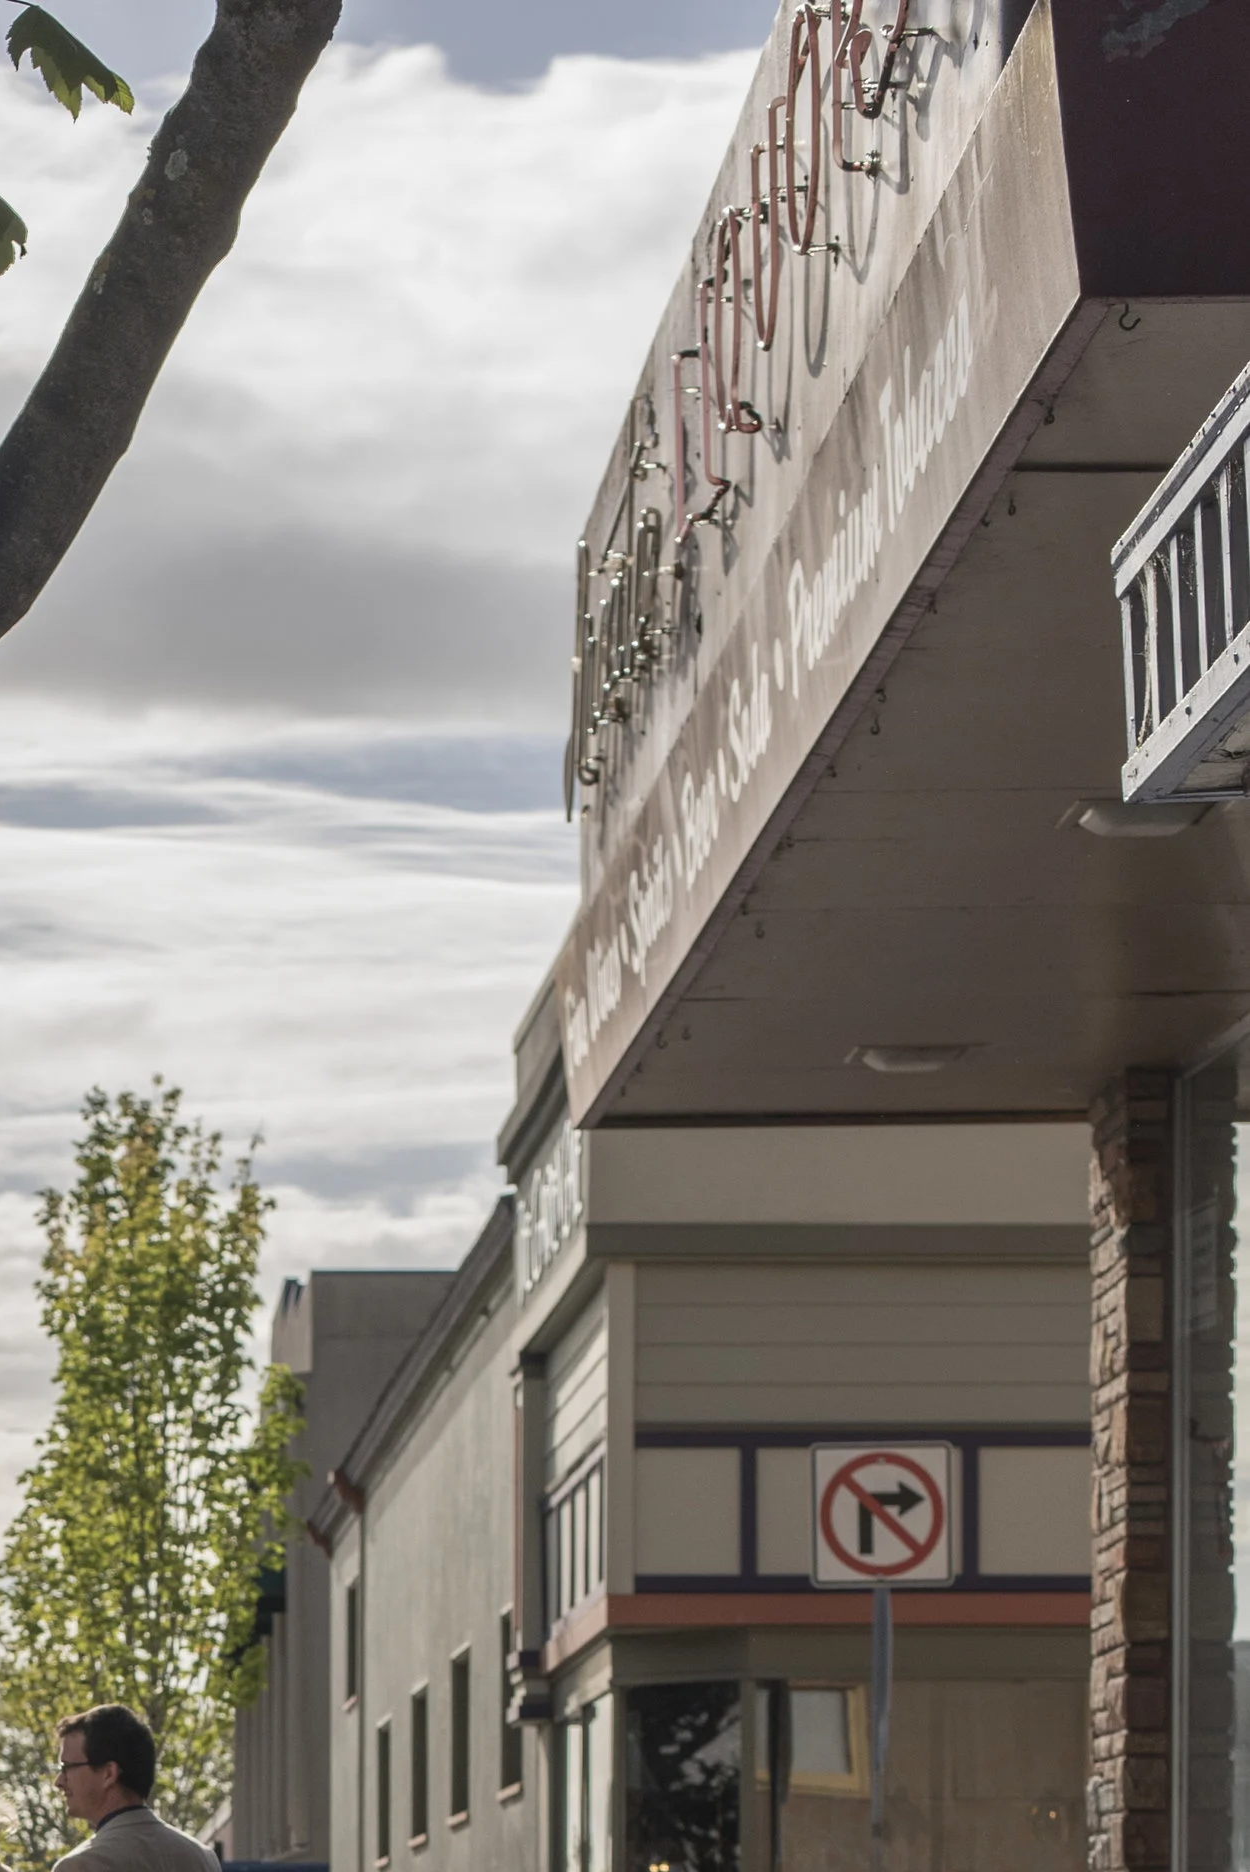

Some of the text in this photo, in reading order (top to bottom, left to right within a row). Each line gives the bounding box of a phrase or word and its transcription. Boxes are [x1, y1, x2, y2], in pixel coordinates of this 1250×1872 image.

[628, 834, 674, 988] Spirits
[681, 769, 720, 892] Beer
[728, 641, 773, 803] Soda
[788, 461, 883, 700] Premium
[878, 287, 973, 533] Tobacco
